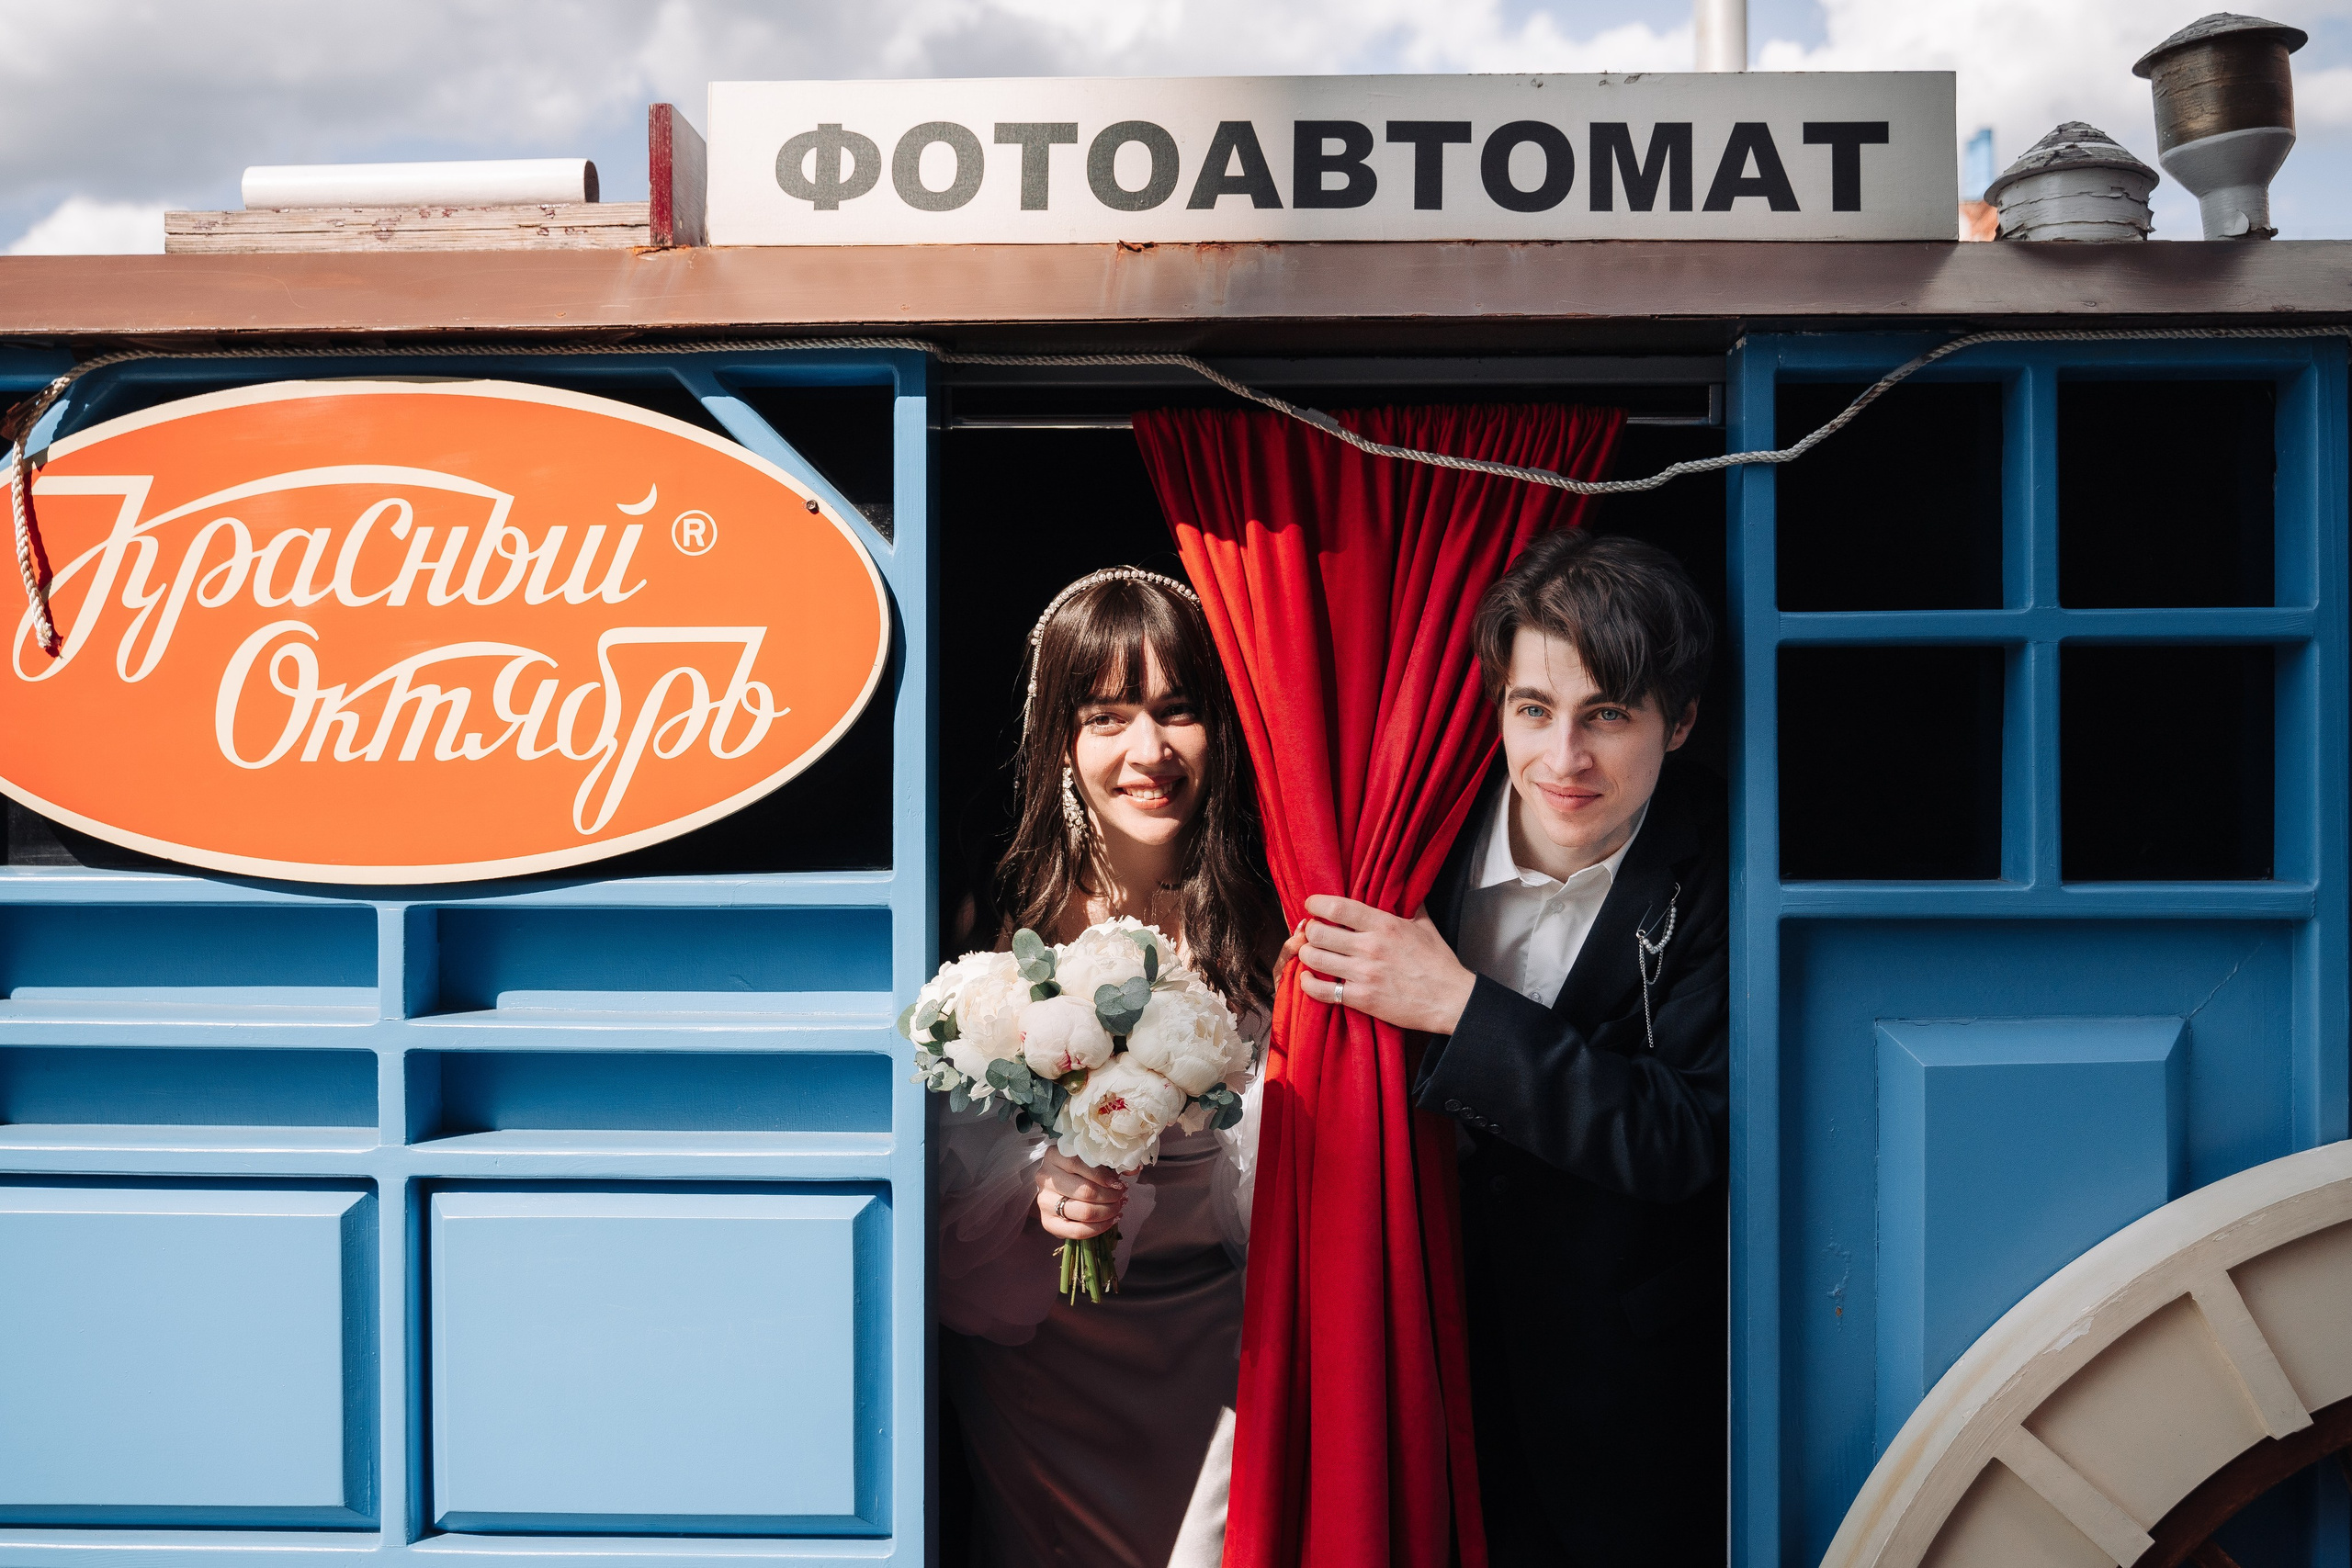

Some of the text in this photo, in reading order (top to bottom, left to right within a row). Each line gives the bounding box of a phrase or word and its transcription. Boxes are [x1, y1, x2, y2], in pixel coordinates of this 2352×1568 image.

[775, 120, 1889, 212] ФОТОАВТОМАТ
[13, 465, 657, 682] Красный
[216, 620, 790, 835] Октябрь
